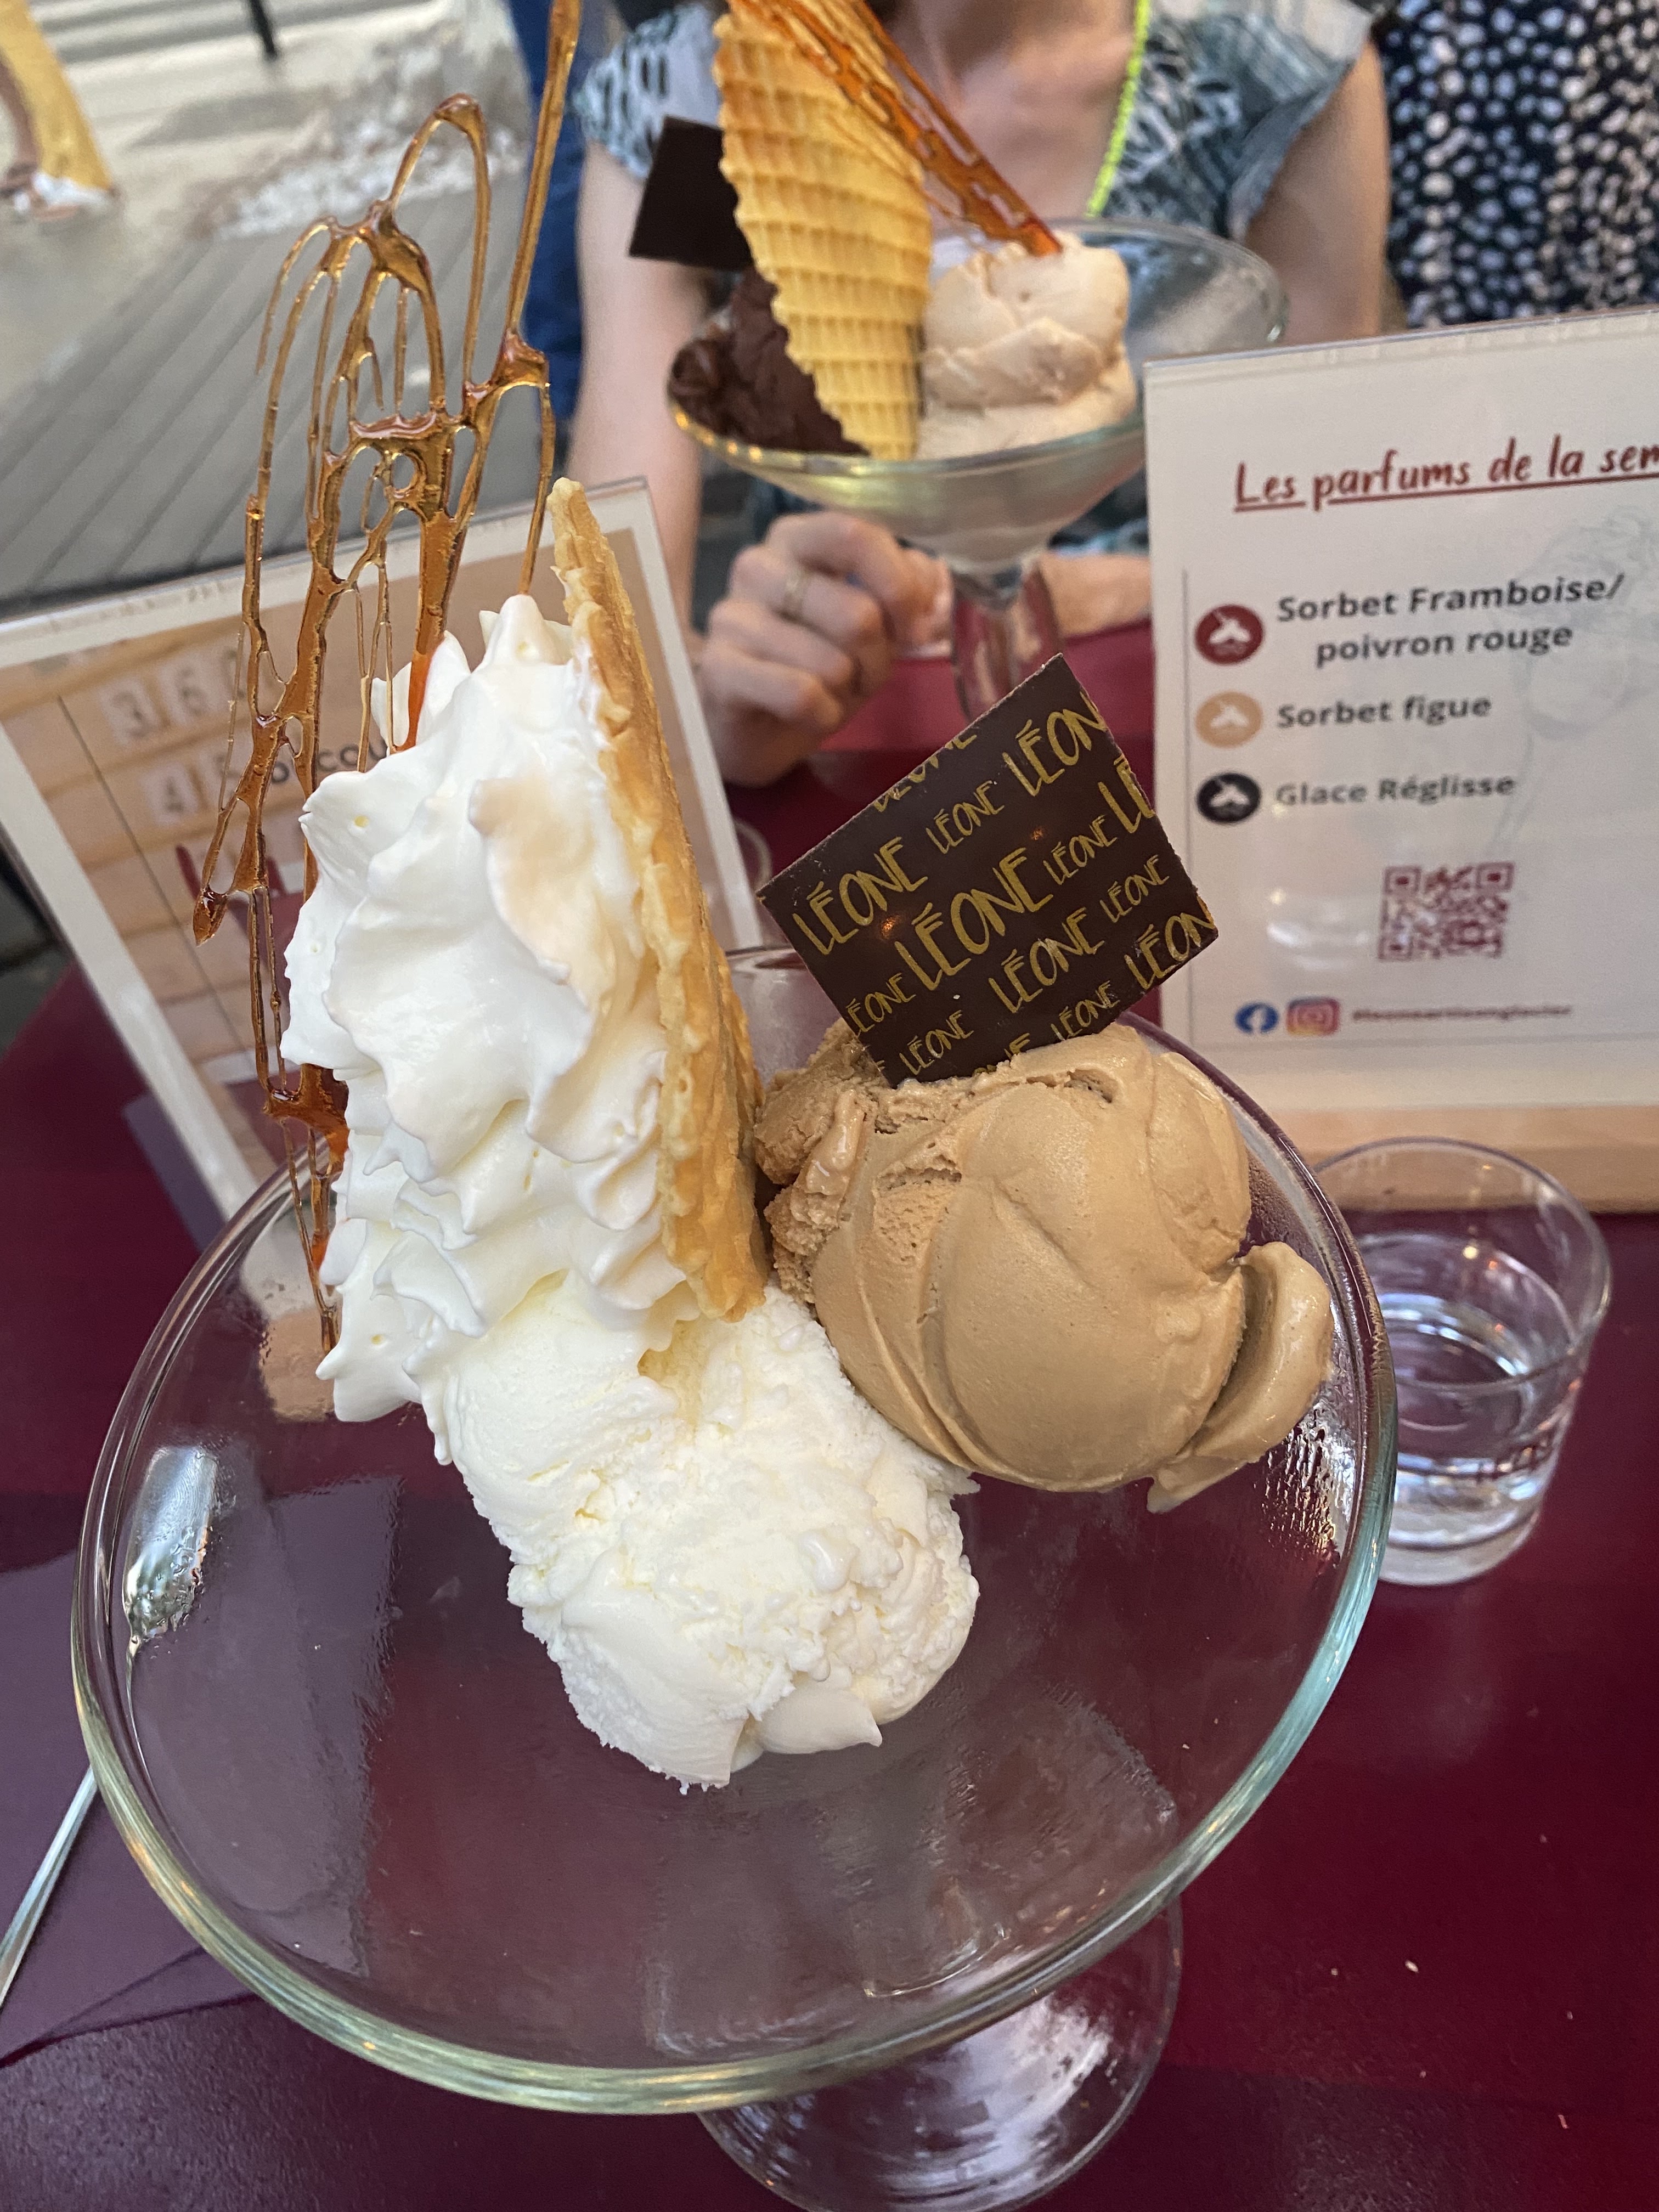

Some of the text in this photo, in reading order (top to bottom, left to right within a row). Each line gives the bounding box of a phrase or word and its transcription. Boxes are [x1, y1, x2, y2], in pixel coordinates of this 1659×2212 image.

[1235, 461, 1296, 505] Les
[1313, 448, 1471, 511] parfums
[1488, 436, 1532, 483] de
[1549, 433, 1584, 478] la
[1277, 573, 1624, 622] Sorbet Framboise/
[1316, 626, 1573, 669] poivron rouge
[1277, 696, 1492, 729] Sorbet figue
[926, 780, 1005, 854] LÉONE
[1275, 775, 1516, 806] Glace Réglisse
[1043, 814, 1118, 885] LÉONE
[793, 836, 927, 955] LÉONE
[895, 847, 1053, 991] LÉONE
[1100, 854, 1170, 923] LÉONE
[989, 907, 1105, 1013] LÉONE
[845, 972, 917, 1038] ÉONE
[1051, 980, 1120, 1041] LÉONE
[899, 1009, 974, 1075] LÉONE
